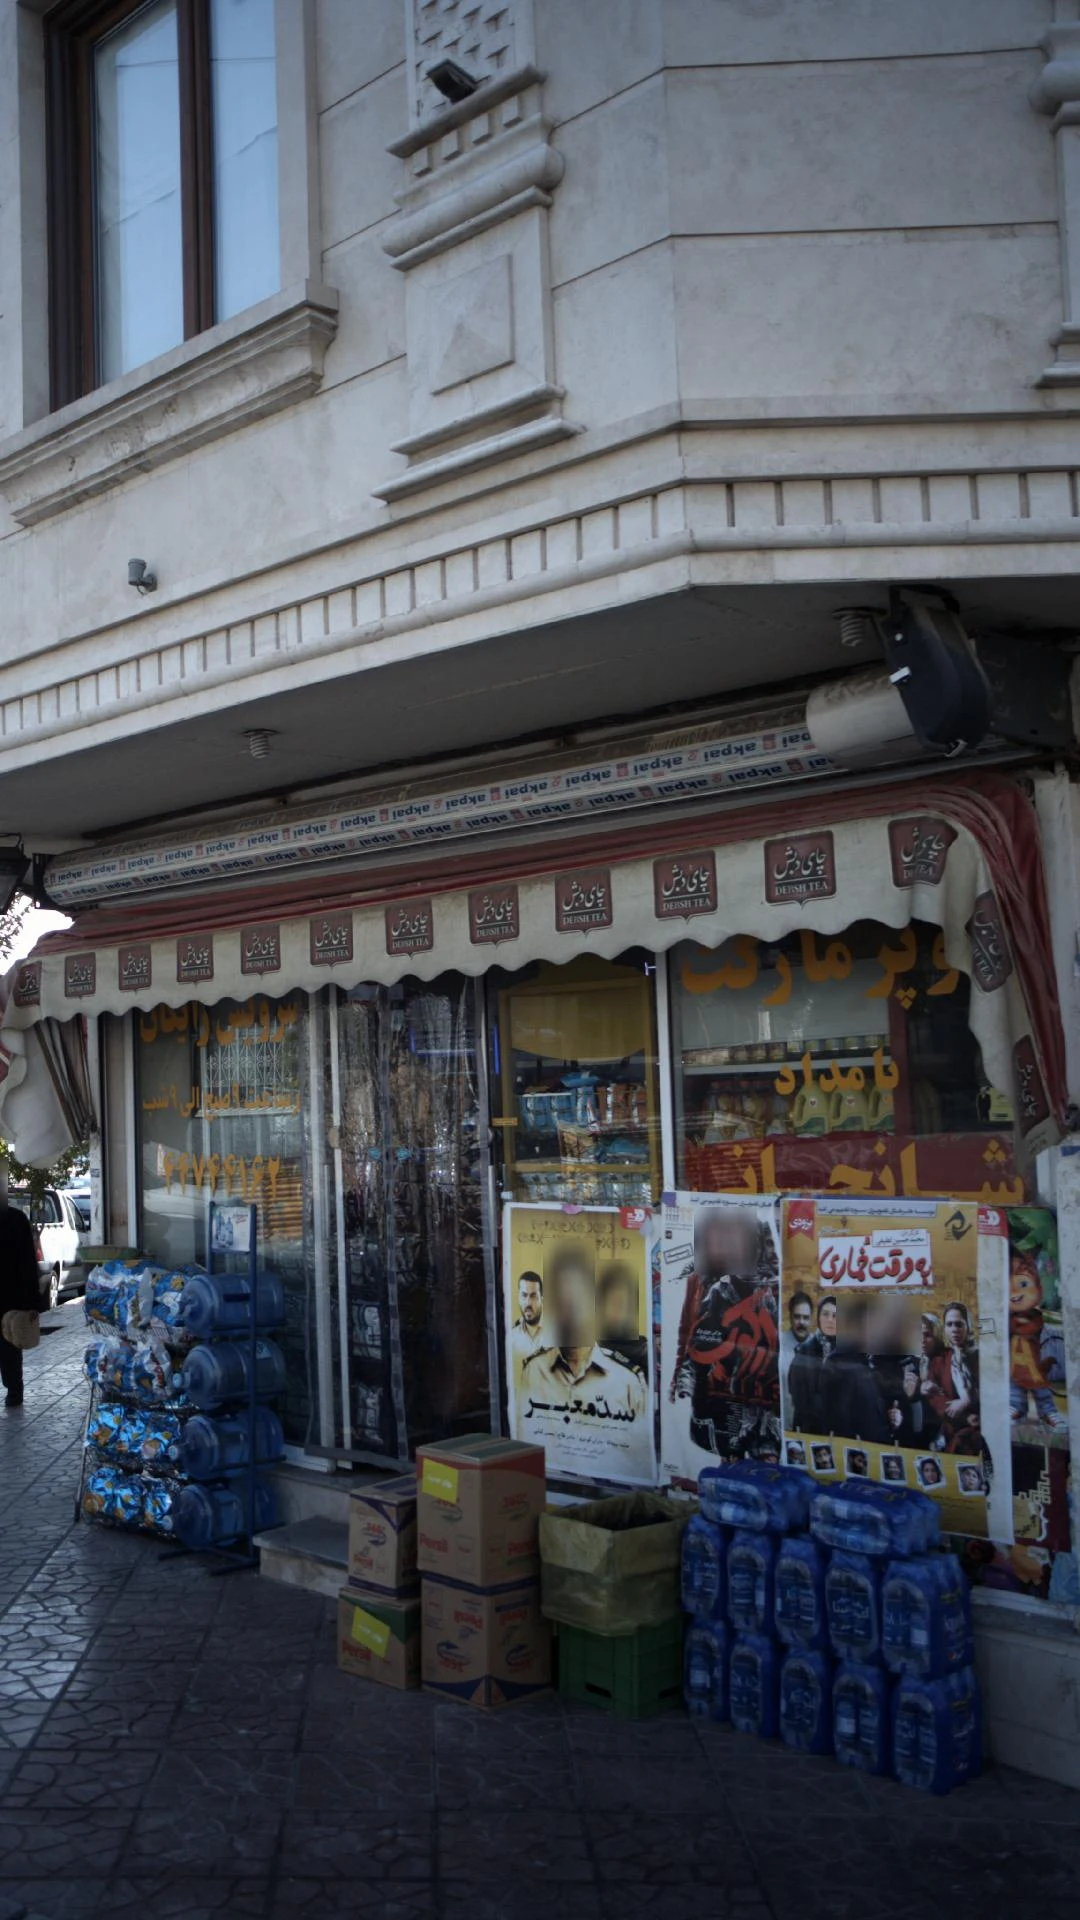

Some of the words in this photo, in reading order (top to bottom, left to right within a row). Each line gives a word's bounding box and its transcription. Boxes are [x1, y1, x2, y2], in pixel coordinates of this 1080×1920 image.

[782, 732, 811, 748] pai
[704, 742, 756, 762] akpai
[633, 756, 682, 775] akpai
[728, 764, 782, 782] akpai
[566, 769, 612, 787] akpai
[505, 782, 548, 798] akpai
[658, 778, 708, 796] akpai
[445, 793, 486, 810] akpai
[588, 790, 636, 808] akpai
[392, 804, 430, 820] akpai
[527, 802, 570, 818] akpai
[340, 814, 376, 830] akpai
[466, 813, 508, 828] akpai
[248, 832, 278, 847] akpai
[294, 824, 327, 838] akpai
[412, 824, 451, 838] akpai
[206, 840, 235, 854] akpai
[311, 842, 346, 855] akpai
[359, 832, 396, 848] akpai
[127, 857, 154, 870] akpai
[165, 850, 192, 862] akpai
[222, 858, 253, 871] akpai
[264, 850, 297, 863] akpai
[774, 845, 800, 880] دبش
[802, 850, 828, 876] چای
[662, 864, 686, 896] دبش
[687, 867, 710, 891] چای
[562, 881, 584, 910] دبش
[584, 884, 606, 908] چای
[775, 883, 808, 897] DEBSH
[808, 880, 828, 892] TEA
[476, 896, 495, 923] دبش
[495, 898, 514, 920] چای
[694, 898, 711, 908] TEA
[392, 909, 410, 936] دبش
[410, 911, 428, 931] چای
[774, 1044, 899, 1104] بامداد
[788, 1218, 814, 1231] بزودی
[868, 1249, 915, 1284] وقت
[916, 1257, 932, 1286] به
[524, 1398, 596, 1424] معبر
